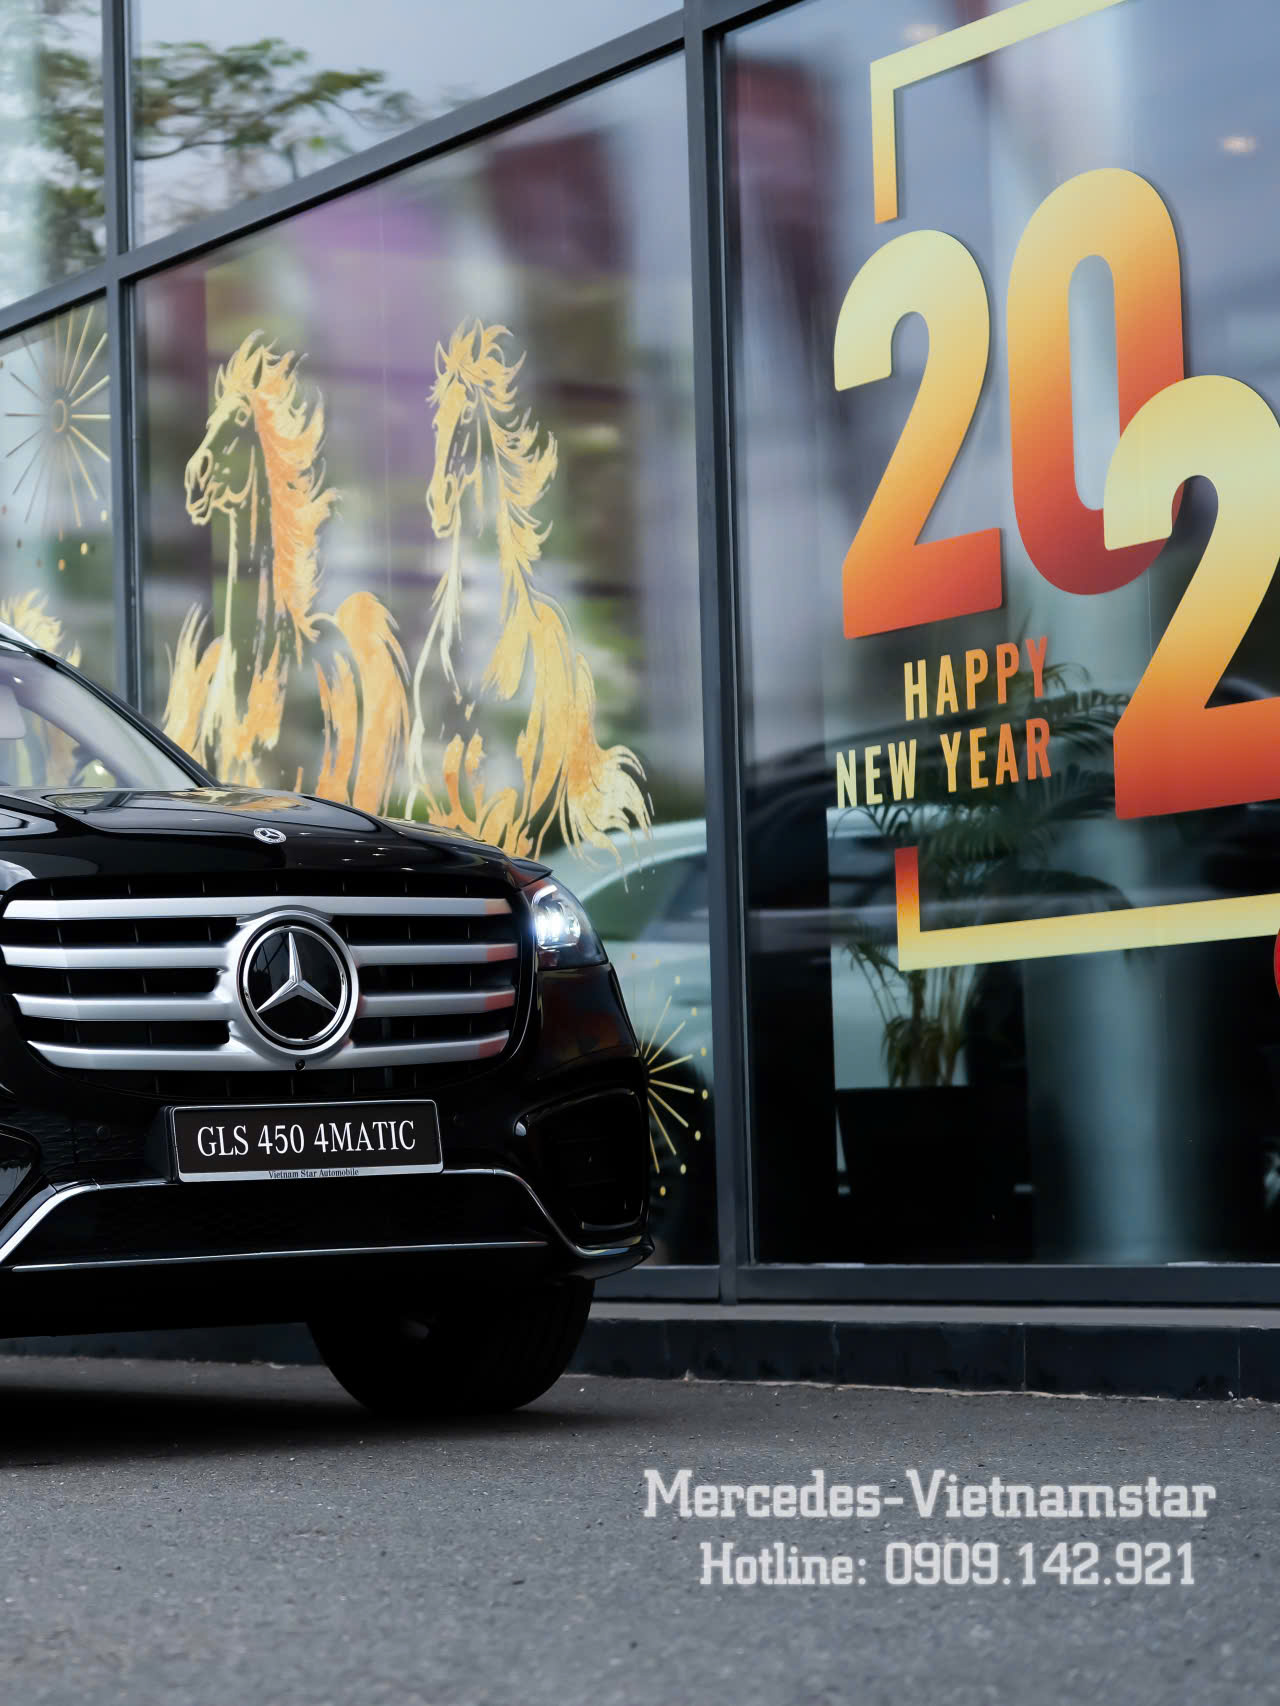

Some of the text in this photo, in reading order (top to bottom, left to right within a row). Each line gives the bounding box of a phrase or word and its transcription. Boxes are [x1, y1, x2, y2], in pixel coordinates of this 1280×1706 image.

[903, 635, 1049, 722] HAPPY
[835, 717, 1052, 810] NEW YEAR
[197, 1120, 416, 1157] GLS 450 4MATIC
[268, 1168, 359, 1179] Vietnam Star Automobile
